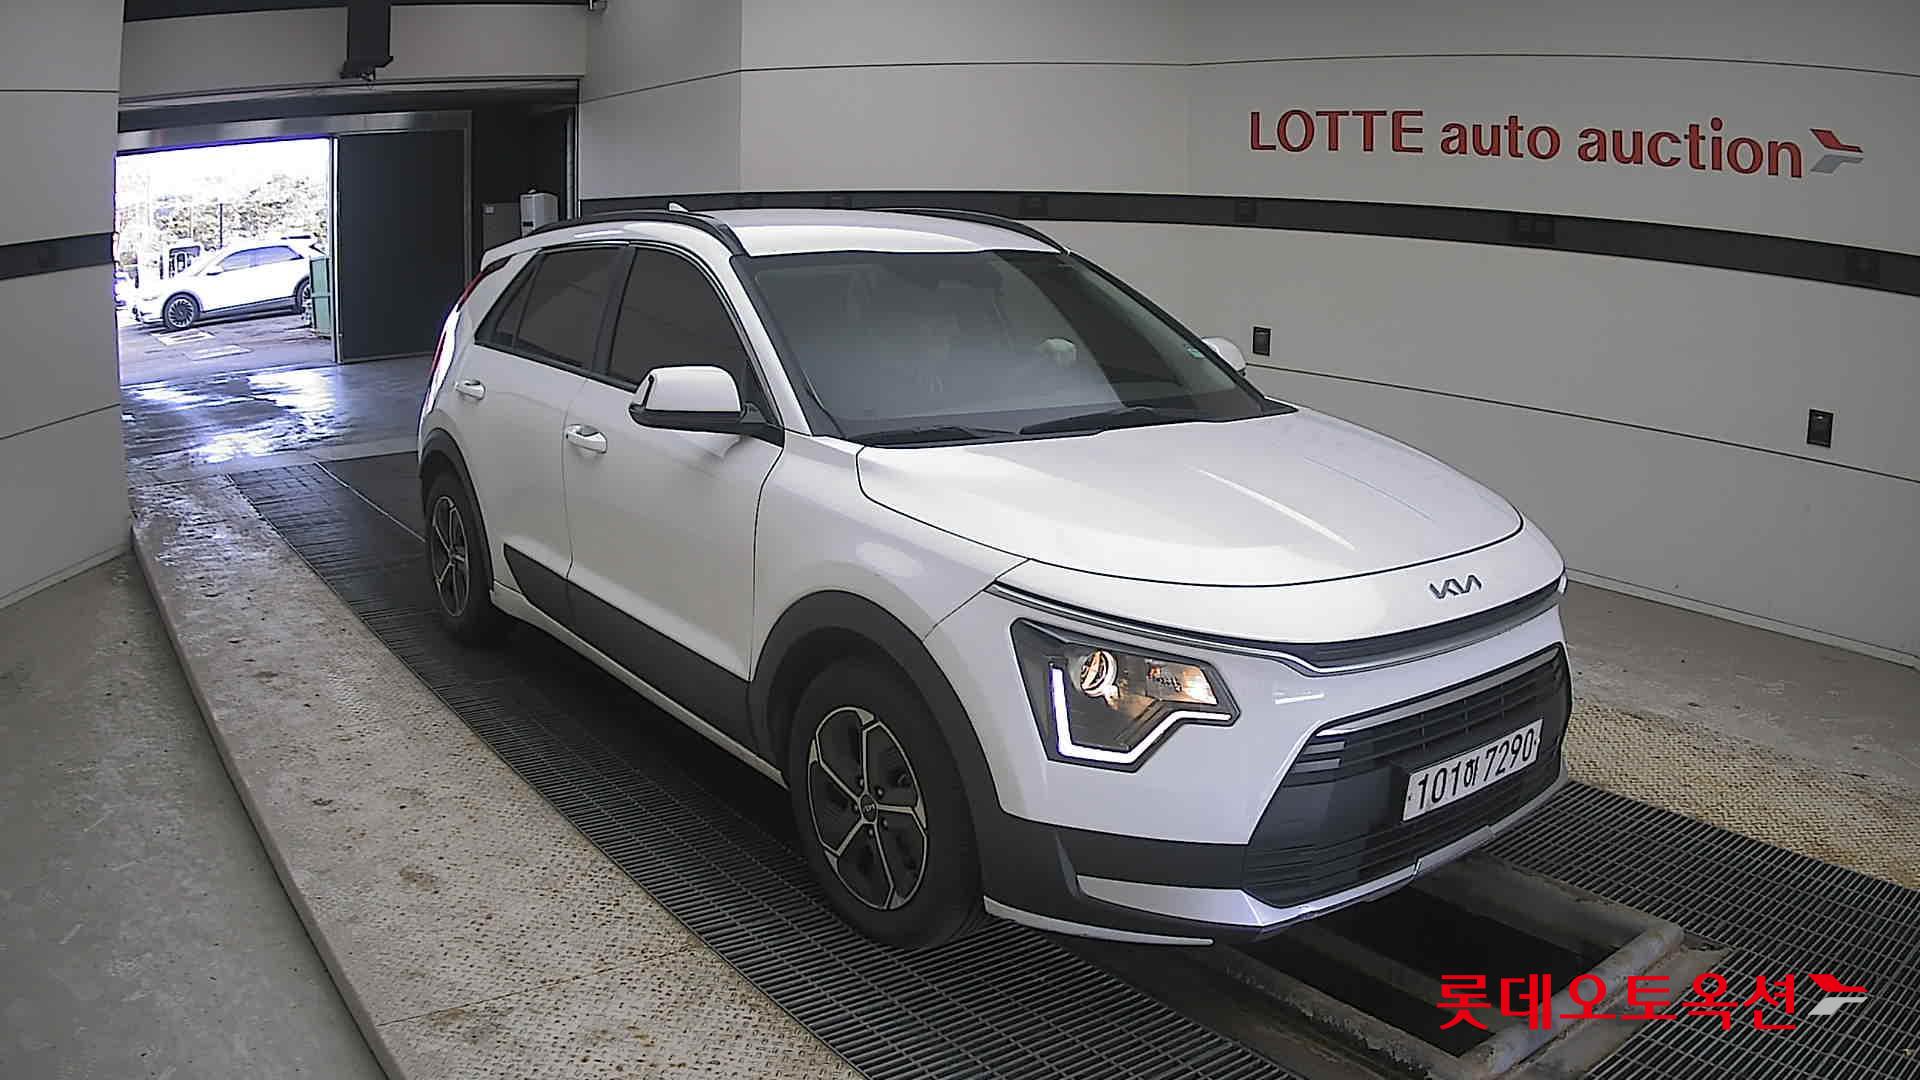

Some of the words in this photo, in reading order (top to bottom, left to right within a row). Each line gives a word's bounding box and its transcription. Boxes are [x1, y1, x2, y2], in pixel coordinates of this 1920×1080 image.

[1250, 110, 1424, 153] LOTTE
[1440, 115, 1561, 160] auto
[1577, 117, 1803, 178] auction
